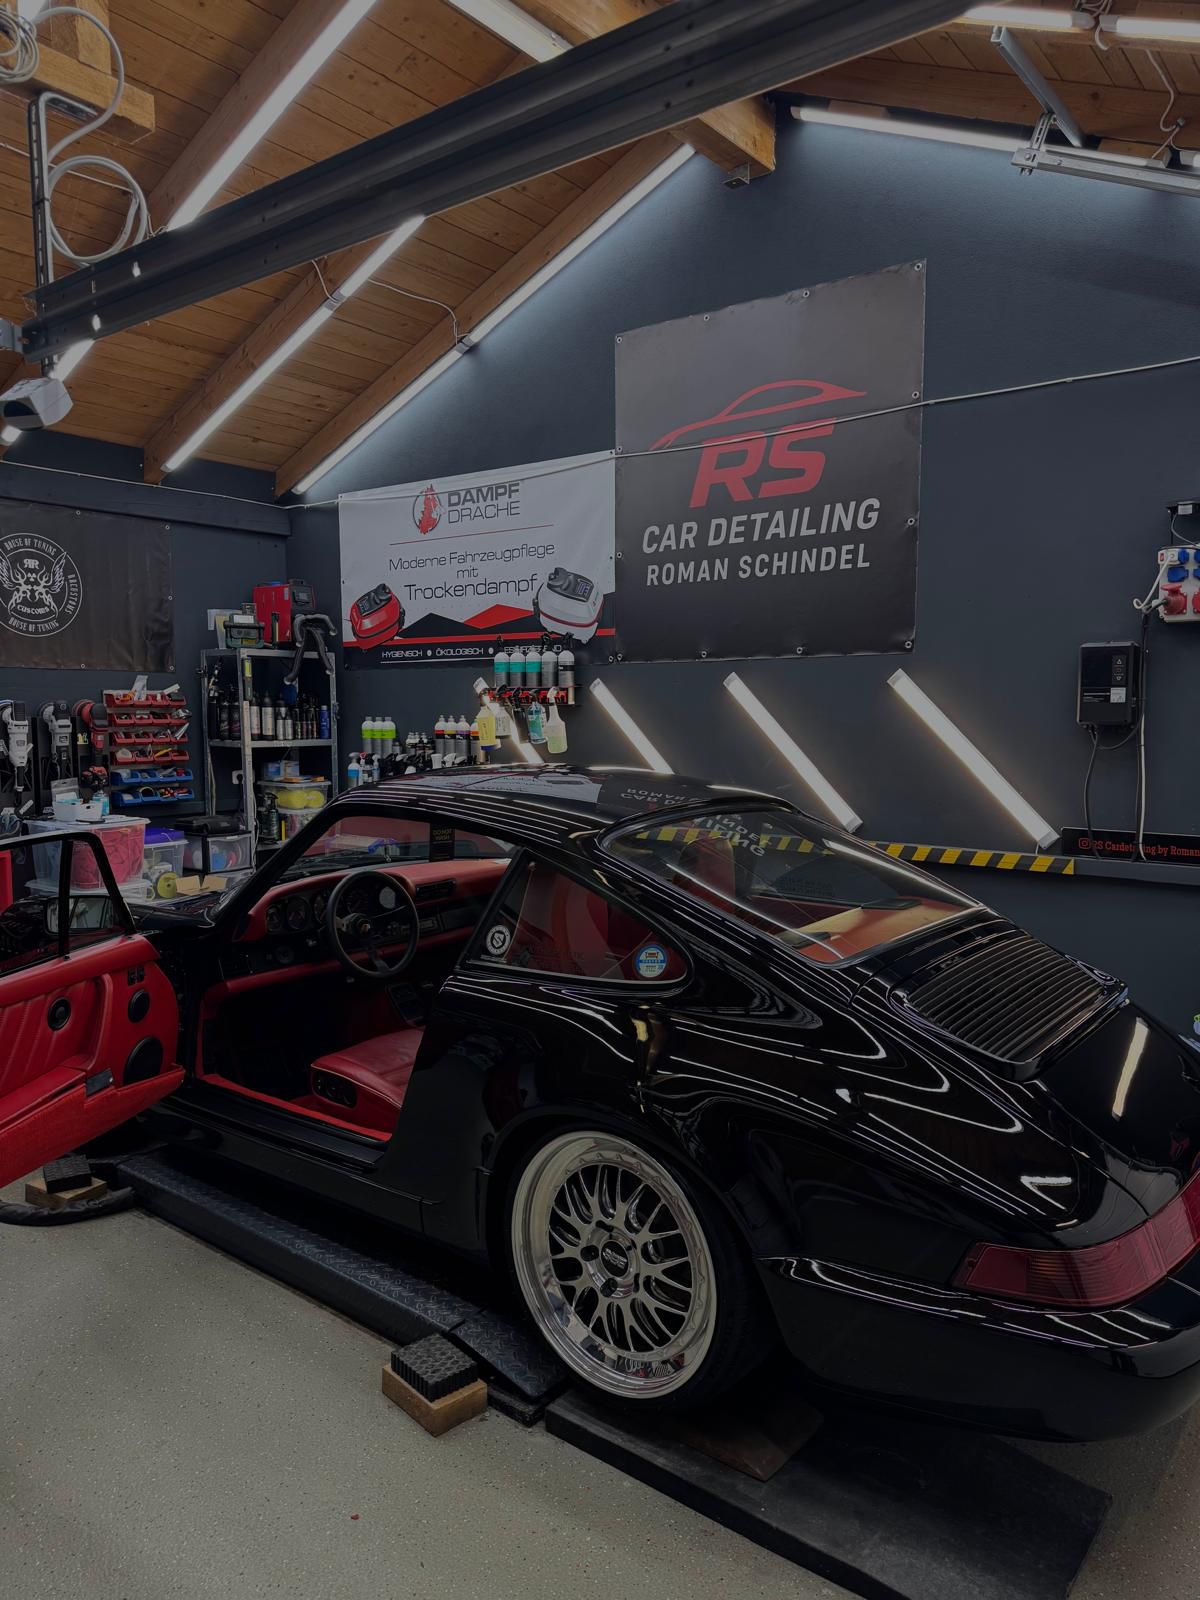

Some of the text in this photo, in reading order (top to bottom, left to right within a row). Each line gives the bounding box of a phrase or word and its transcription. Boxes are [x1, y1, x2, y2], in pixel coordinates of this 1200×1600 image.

[689, 417, 838, 508] RS
[448, 481, 520, 507] DAMPF
[448, 501, 520, 524] DRACHE
[642, 497, 881, 553] CAR DETAILING
[389, 543, 555, 572] Moderne Fahrzeugpflege
[646, 543, 871, 586] ROMAN SCHINDEL
[456, 567, 478, 578] mit
[404, 574, 538, 602] Trockendampf
[1158, 844, 1168, 857] by
